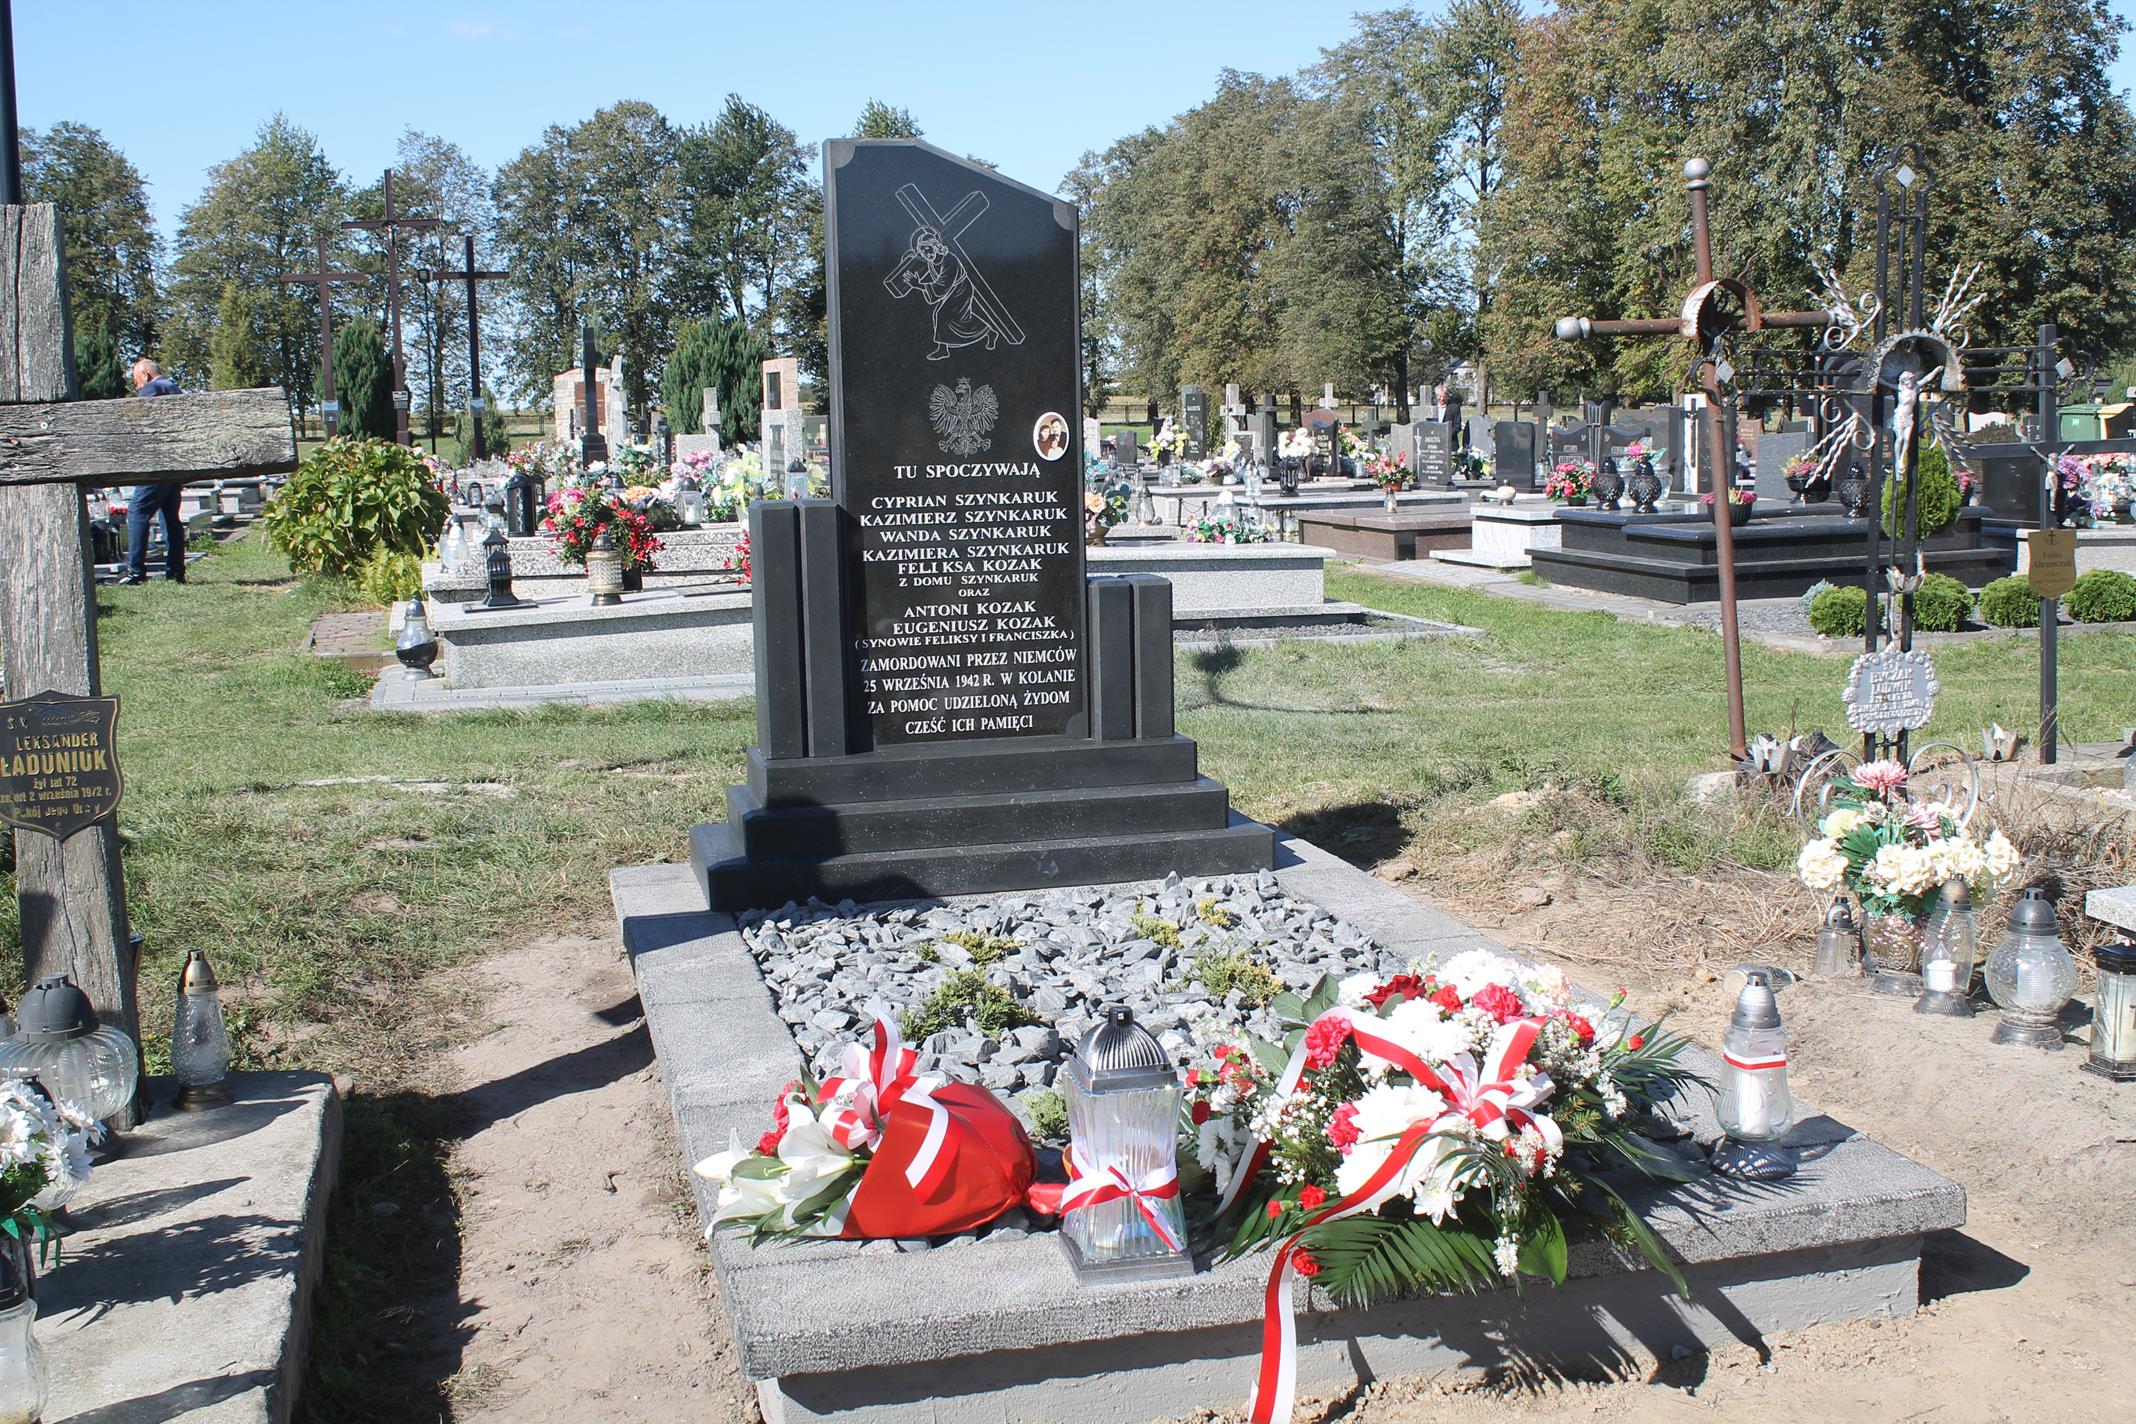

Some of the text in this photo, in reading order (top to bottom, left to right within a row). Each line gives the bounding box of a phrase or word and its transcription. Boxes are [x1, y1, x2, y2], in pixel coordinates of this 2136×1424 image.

[894, 463, 1040, 479] TU SPOCZYWAJĄ
[871, 491, 1058, 509] CYPRIAN SZYNKARUK
[860, 508, 1068, 527] KAZIMIERZ SZYNKARUK
[880, 525, 1052, 542] WANDA SZYNKARUK
[862, 542, 1070, 562] KAZIMIERA SZYNKARUK
[983, 558, 1042, 572] KOZAK
[899, 573, 1039, 587] Z DOMU SZYNKARUK
[958, 588, 990, 597] ORAZ
[904, 601, 1037, 618] ANTONI KOZAK
[893, 616, 1056, 634] EUGENIUSZ KOZAK
[862, 637, 922, 649] SYNOWIE
[925, 634, 978, 645] FELIKSY
[981, 634, 986, 642] I
[989, 630, 1067, 642] FRANCISZKA
[860, 646, 1077, 672] ZAMORDOWANI PRZEZ NIEMCÓW
[864, 669, 1076, 693] 25 WRZEŚNIA 1942 R. W KOLANIE
[868, 691, 1070, 715] ZA POMOC UDZIELONĄ ŻYDOM
[906, 715, 1033, 735] CZEŚĆ ICH PAMIĘCI
[0, 749, 108, 777] ŁADUNIUK
[65, 776, 78, 786] 72
[29, 791, 36, 802] 2
[39, 788, 79, 801] września
